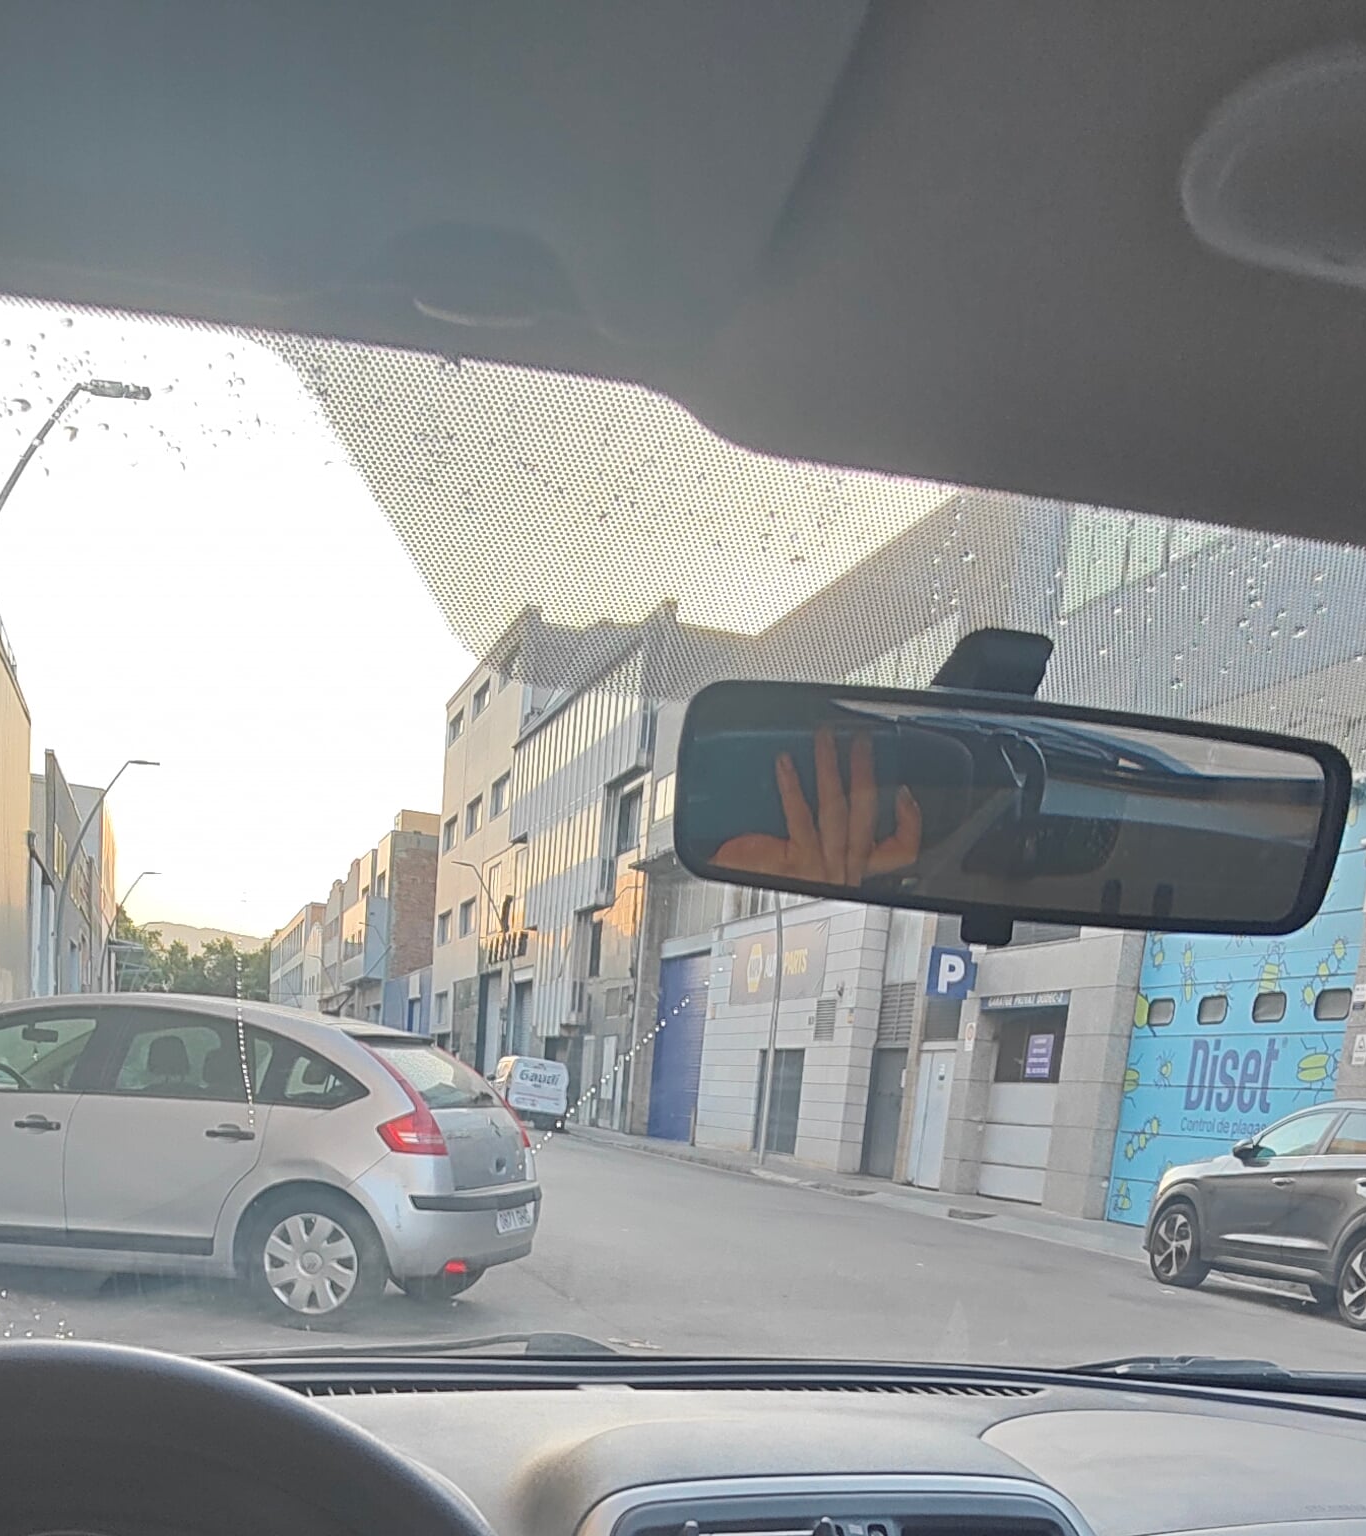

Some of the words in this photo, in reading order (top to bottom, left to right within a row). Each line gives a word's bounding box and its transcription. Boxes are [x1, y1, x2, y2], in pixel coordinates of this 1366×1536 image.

[937, 953, 965, 994] P
[1184, 1038, 1280, 1114] Diset
[1180, 1117, 1215, 1132] Control
[1217, 1118, 1230, 1134] de
